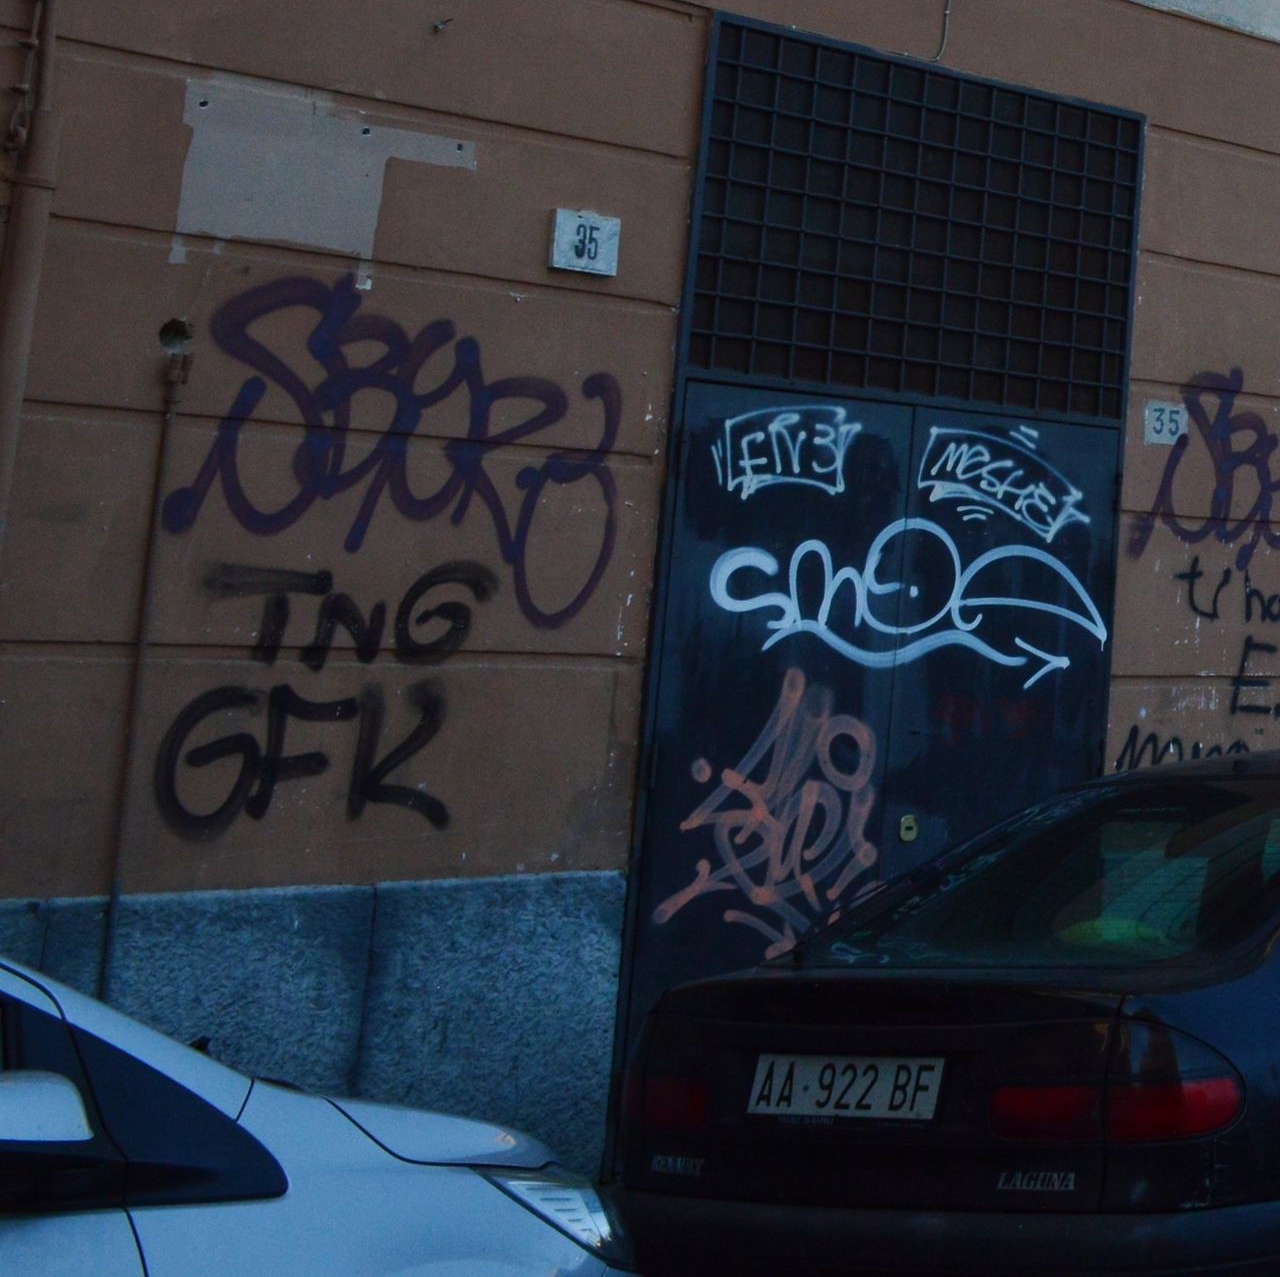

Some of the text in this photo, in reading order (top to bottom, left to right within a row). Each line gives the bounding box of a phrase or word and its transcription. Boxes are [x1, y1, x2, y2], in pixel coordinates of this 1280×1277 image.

[574, 224, 600, 260] 35
[1153, 409, 1180, 436] 35
[756, 1061, 936, 1112] AA 922 BF
[995, 1171, 1076, 1191] LAGUNA
